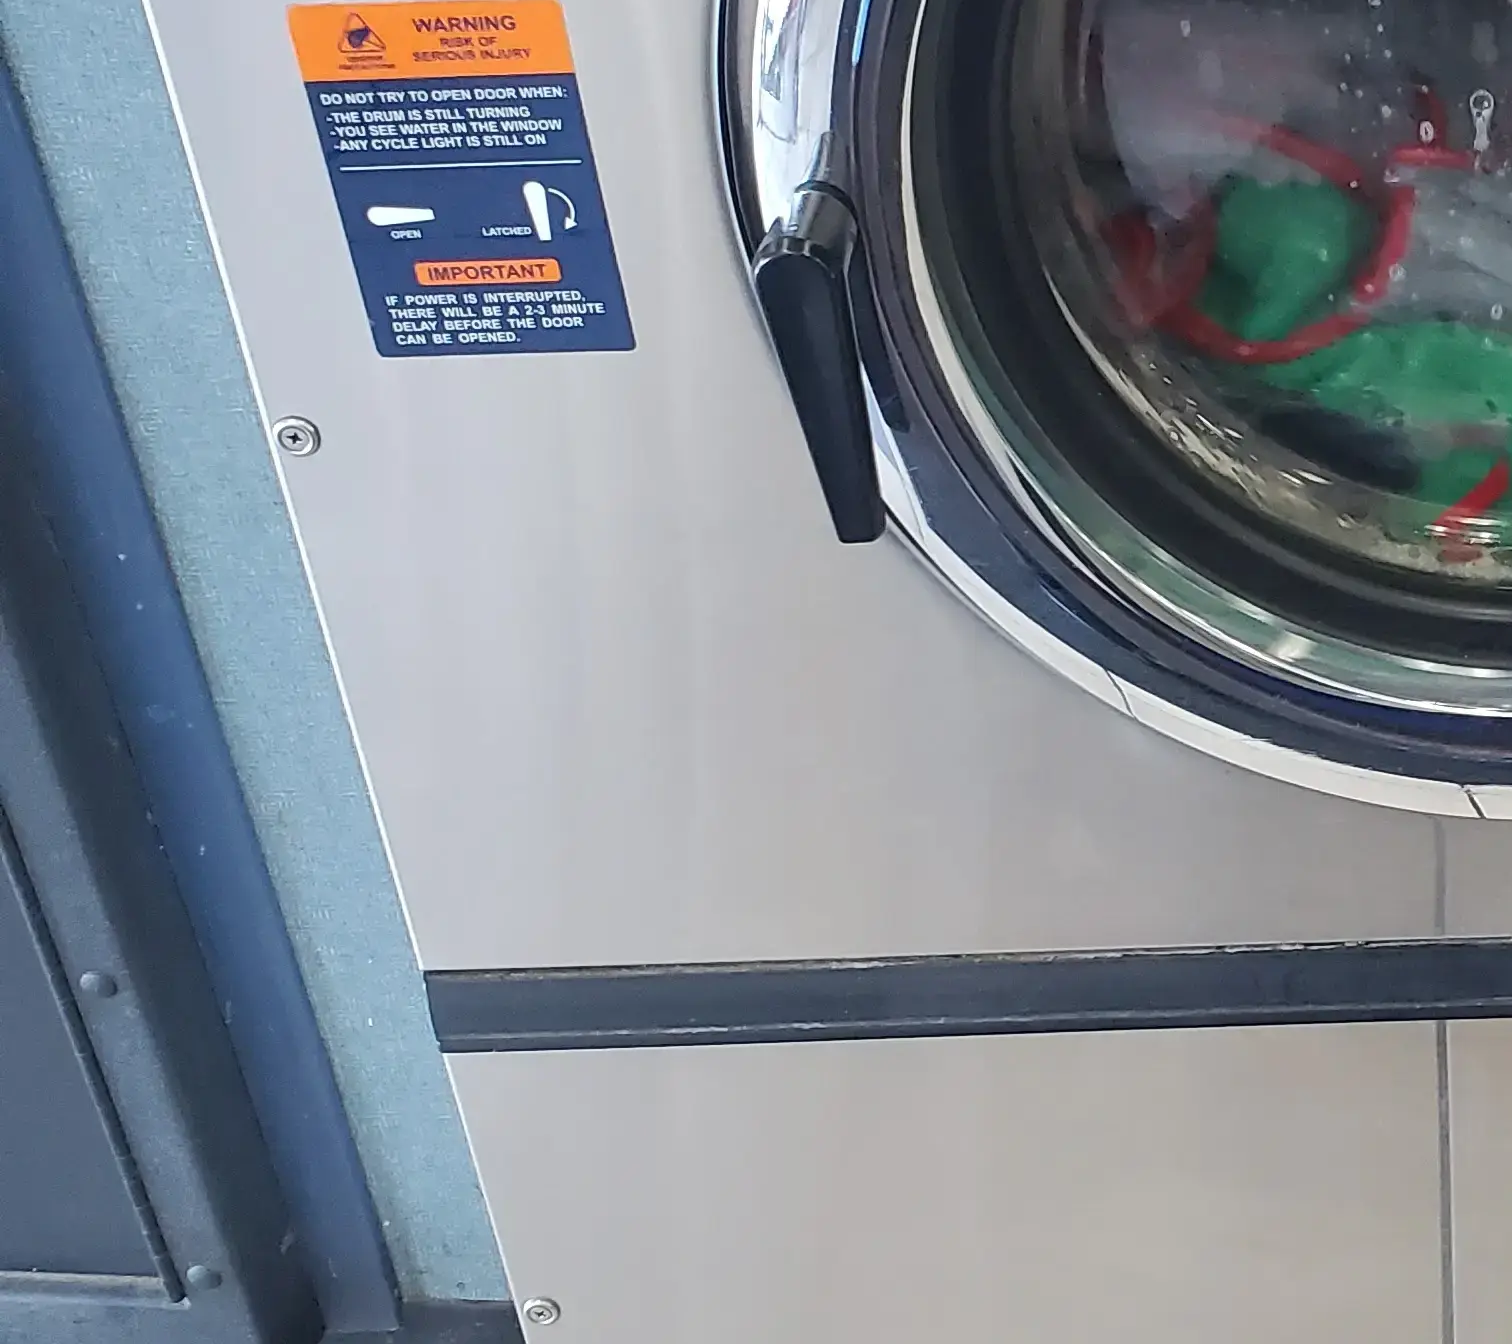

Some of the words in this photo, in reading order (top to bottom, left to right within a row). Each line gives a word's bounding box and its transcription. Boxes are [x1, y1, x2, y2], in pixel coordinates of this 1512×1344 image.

[411, 14, 517, 33] WARNING
[439, 36, 474, 49] RISK
[477, 35, 498, 48] OF
[411, 49, 476, 63] SERIOUS
[480, 47, 531, 61] INJURY
[319, 92, 343, 106] DO
[344, 91, 375, 105] NOT
[376, 90, 406, 103] TRY
[407, 89, 429, 103] TO
[430, 88, 473, 102] OPEN
[473, 87, 518, 101] DOOR
[518, 85, 569, 99] WHEN:
[325, 111, 362, 124] -THE
[361, 109, 406, 123] DRUM
[407, 109, 423, 121] IS
[424, 107, 466, 121] STILL
[465, 105, 531, 120] TURNING
[329, 124, 367, 138] -YOU
[367, 123, 399, 137] SEE
[398, 121, 451, 136] WATER
[451, 121, 468, 134] IN
[468, 120, 500, 133] THE
[499, 118, 563, 133] WINDOW
[333, 138, 369, 152] -ANY
[370, 136, 420, 151] CYCLE
[420, 135, 464, 150] LIGHT
[465, 135, 482, 147] IS
[481, 133, 524, 148] STILL
[523, 132, 548, 146] ON
[389, 228, 423, 240] OPEN
[481, 225, 533, 238] LATCHED
[427, 262, 547, 282] IMPORTANT
[384, 294, 399, 307] IF
[403, 293, 458, 306] POWER
[462, 292, 479, 305] IS
[388, 307, 438, 320] THERE
[440, 305, 479, 318] WILL
[481, 305, 504, 317] BE
[507, 304, 521, 316] A
[523, 304, 547, 316] 2-3
[550, 301, 607, 315] MINUTE
[391, 320, 439, 333] DELAY
[443, 318, 504, 331] BEFORE
[506, 317, 538, 330] THE
[540, 316, 586, 329] DOOR
[395, 334, 428, 346] CAN
[431, 332, 455, 345] BE
[457, 330, 523, 345] OPENED.
